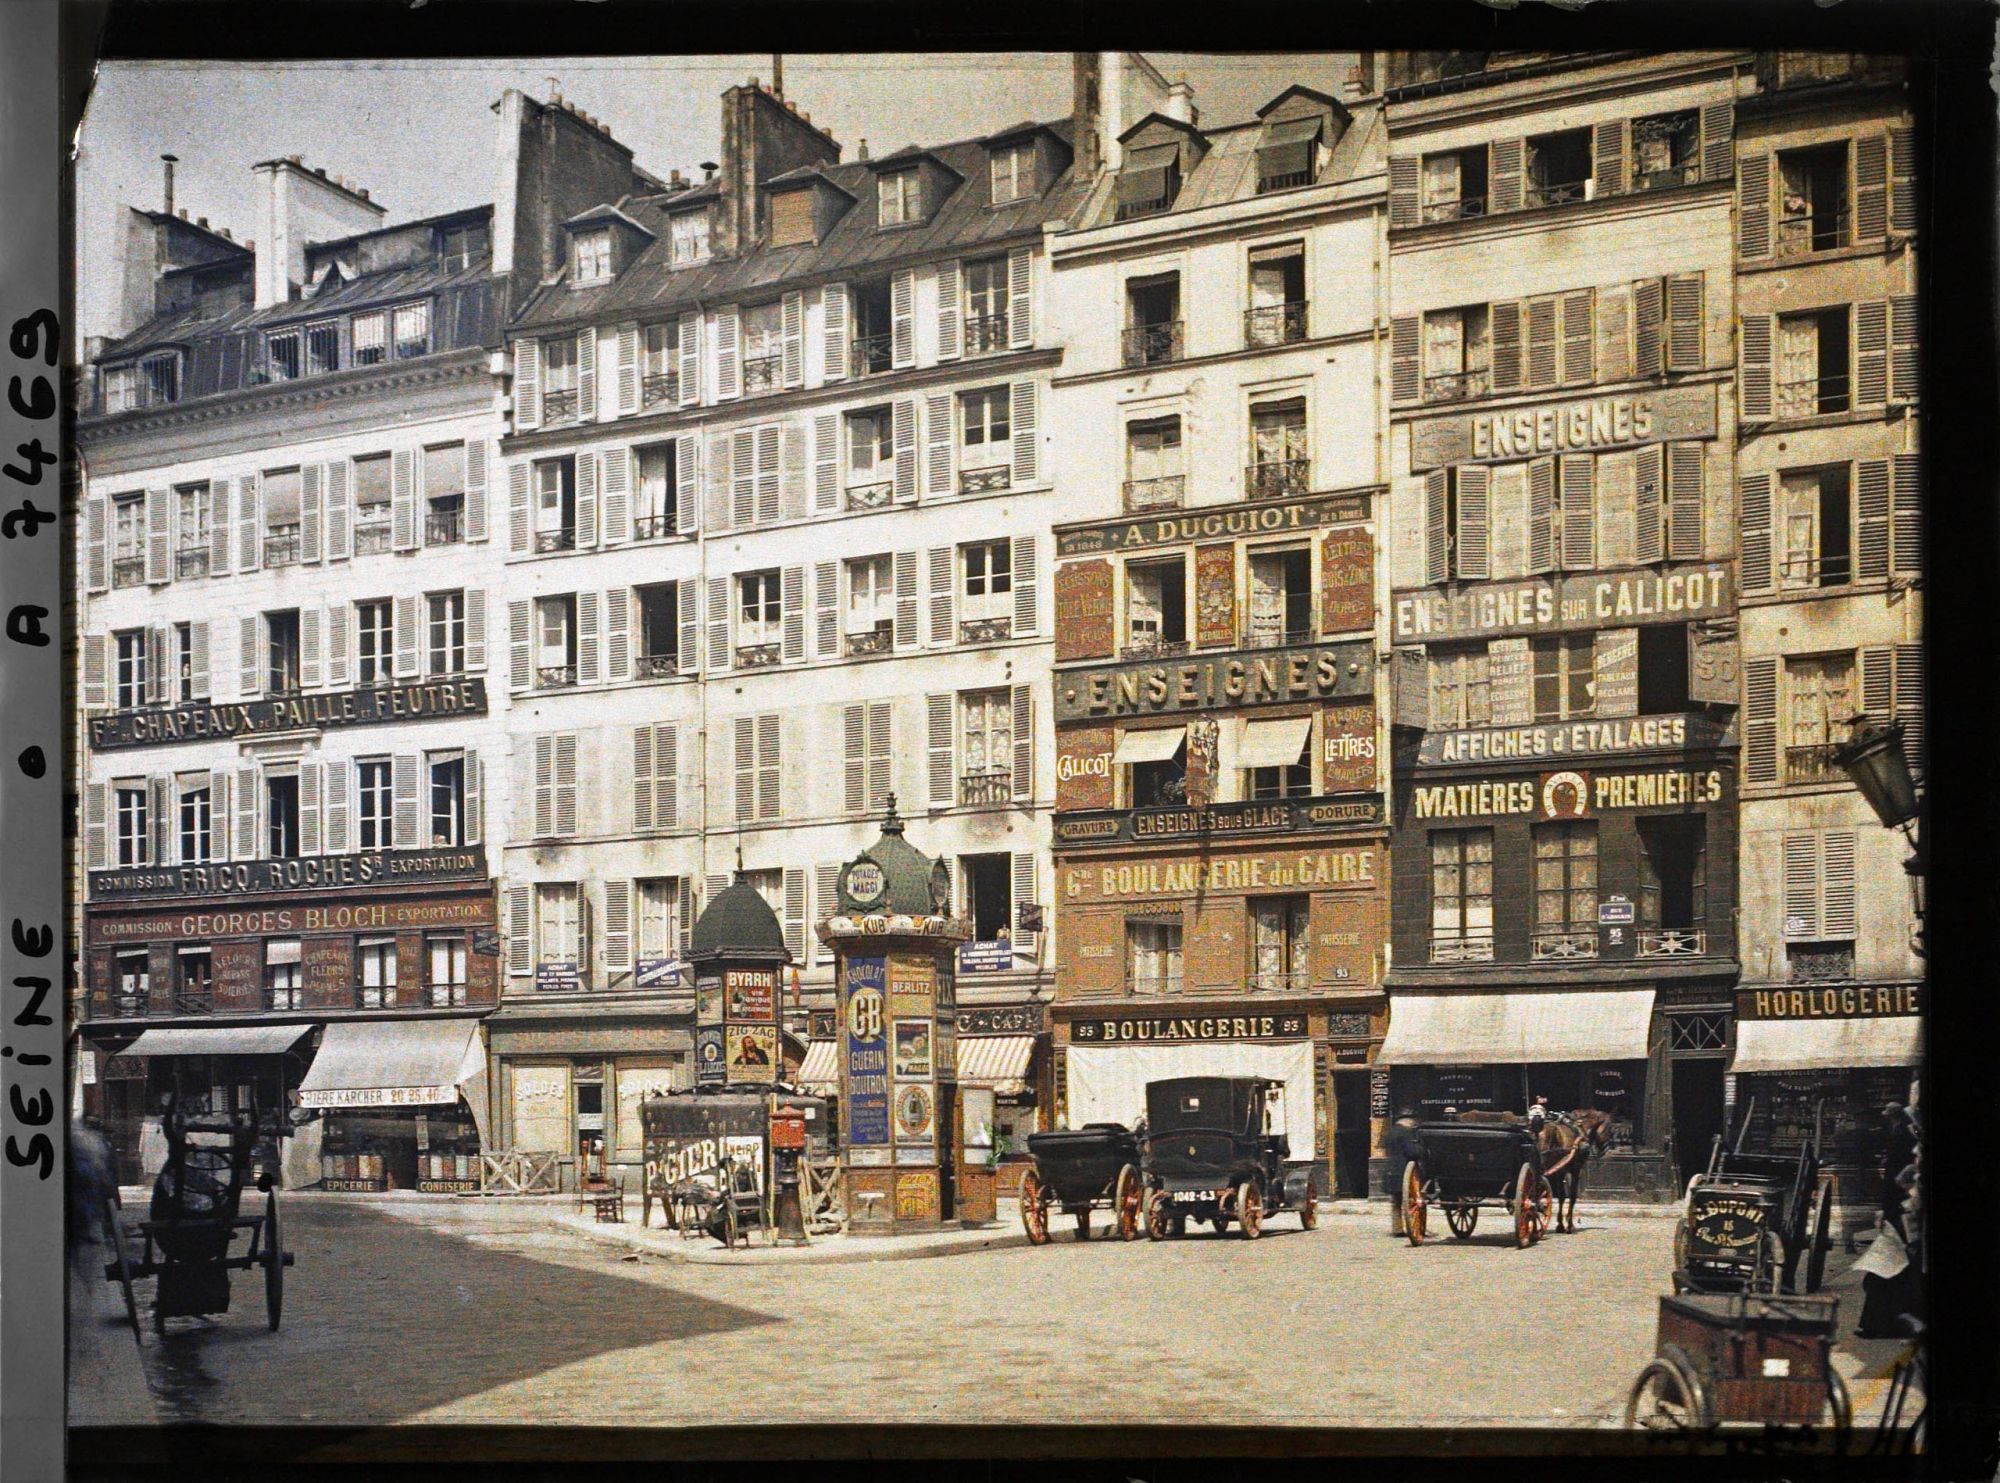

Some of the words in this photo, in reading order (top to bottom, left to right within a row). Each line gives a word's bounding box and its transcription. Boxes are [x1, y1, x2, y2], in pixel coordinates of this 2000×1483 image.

[1, 308, 59, 540] 7469
[1472, 400, 1652, 458] ENSEIGNES
[1122, 524, 1151, 546] A.
[1156, 505, 1305, 542] DUGUIOT
[1326, 541, 1371, 562] LETTRES
[1397, 589, 1554, 636] ENSEIGNES
[1560, 598, 1588, 621] SUR
[1595, 571, 1725, 618] CALICOT
[6, 604, 50, 648] A
[1489, 663, 1532, 676] RELIEF
[1088, 651, 1337, 712] ENSEIGNES
[132, 704, 255, 741] CHAPEAUX
[272, 694, 356, 727] PAILLE
[374, 682, 477, 718] FEUTRE
[1504, 711, 1530, 723] FOUR
[1324, 732, 1375, 762] LETTRES
[1442, 728, 1547, 762] AFFICHES
[1057, 752, 1113, 781] CALICOT
[1414, 780, 1534, 819] MATIÈRES
[1594, 769, 1723, 809] PREMIÈRES
[1137, 811, 1216, 834] ENSEIGNES
[1243, 806, 1290, 828] GLACE
[1316, 804, 1370, 819] DORURE
[1064, 822, 1113, 835] GRAVURE
[97, 874, 175, 891] COMMISSION
[268, 858, 355, 890] ROCHE
[390, 855, 476, 873] EXPORTATION
[1269, 860, 1294, 887] du
[1298, 851, 1376, 884] CAIRE
[852, 882, 879, 894] MAGGI
[101, 920, 173, 936] COMMISSION
[181, 911, 292, 936] GEORGES
[305, 905, 386, 929] BLOCH
[397, 904, 483, 921] EXPORTATION
[863, 919, 887, 935] KUB
[923, 919, 944, 935] KUB
[974, 942, 999, 950] ACHAT
[311, 965, 344, 976] FLEURS
[728, 971, 771, 987] BYRRH
[847, 963, 885, 985] CHOCOLAT
[1336, 968, 1348, 978] 93
[892, 982, 931, 994] BERLITZ
[1755, 986, 1920, 1017] HORLOGERIE
[853, 993, 885, 1037] GB
[728, 1026, 748, 1037] ZIG
[752, 1025, 775, 1039] ZAG
[1102, 1017, 1275, 1041] BOULANGERIE
[1282, 1019, 1300, 1032] 93
[390, 1088, 404, 1103] 20
[850, 1074, 887, 1095] BOUTRON
[326, 1180, 374, 1192] EPICERIE
[419, 1180, 475, 1192] CONFISERIE
[1703, 1200, 1765, 1223] DUPONT
